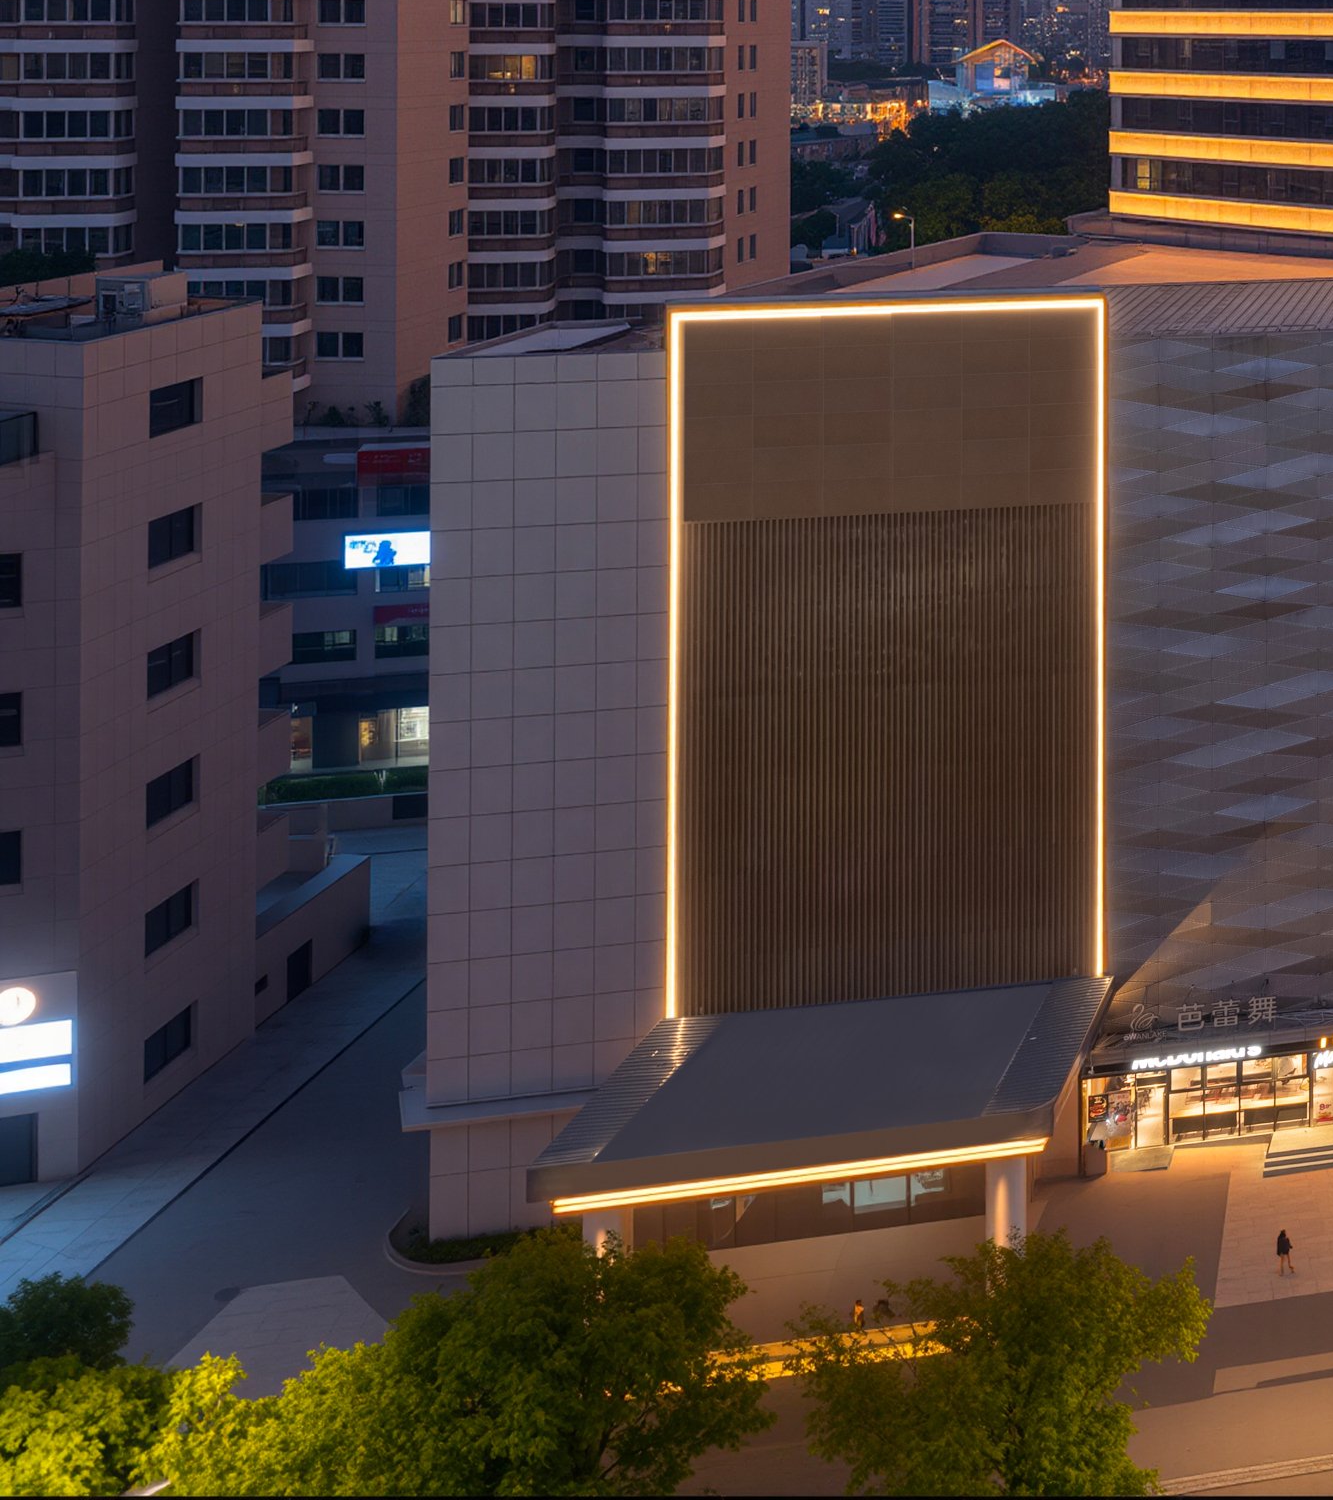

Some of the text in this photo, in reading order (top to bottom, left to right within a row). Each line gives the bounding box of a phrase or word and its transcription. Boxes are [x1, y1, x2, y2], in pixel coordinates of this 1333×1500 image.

[1176, 995, 1277, 1032] 芭蕾舞
[1131, 1045, 1263, 1071] McDonalds
